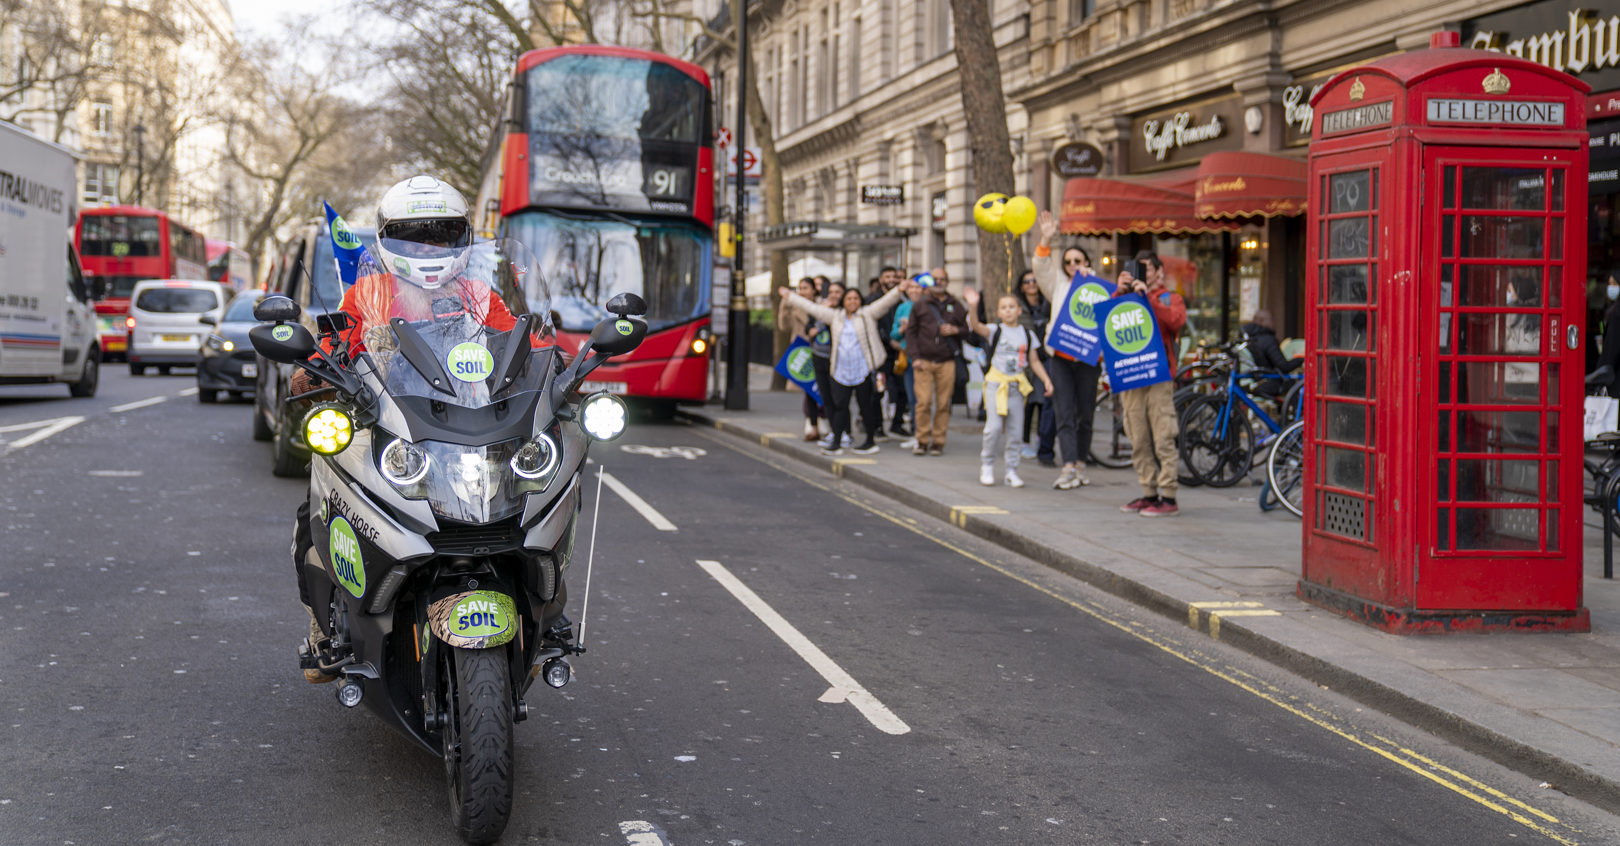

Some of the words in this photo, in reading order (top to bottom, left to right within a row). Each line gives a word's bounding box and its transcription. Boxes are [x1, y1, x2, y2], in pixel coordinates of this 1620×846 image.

[1326, 102, 1391, 131] TELEPHONE
[1432, 101, 1559, 122] TELEPHONE
[1174, 112, 1221, 147] Concerto
[544, 167, 598, 185] Crouch
[653, 169, 676, 196] 91
[337, 230, 361, 244] SOIL
[1111, 308, 1144, 331] SAVE
[1115, 326, 1147, 347] SOIL
[454, 349, 486, 361] SAVE
[1140, 351, 1158, 363] NOW
[456, 361, 487, 374] SOIL
[329, 488, 352, 518] CRAZY
[350, 512, 381, 542] HORSE
[334, 527, 357, 563] SAVE
[335, 552, 361, 588] SOIL
[457, 600, 499, 617] SAVE
[459, 612, 500, 631] SOIL
